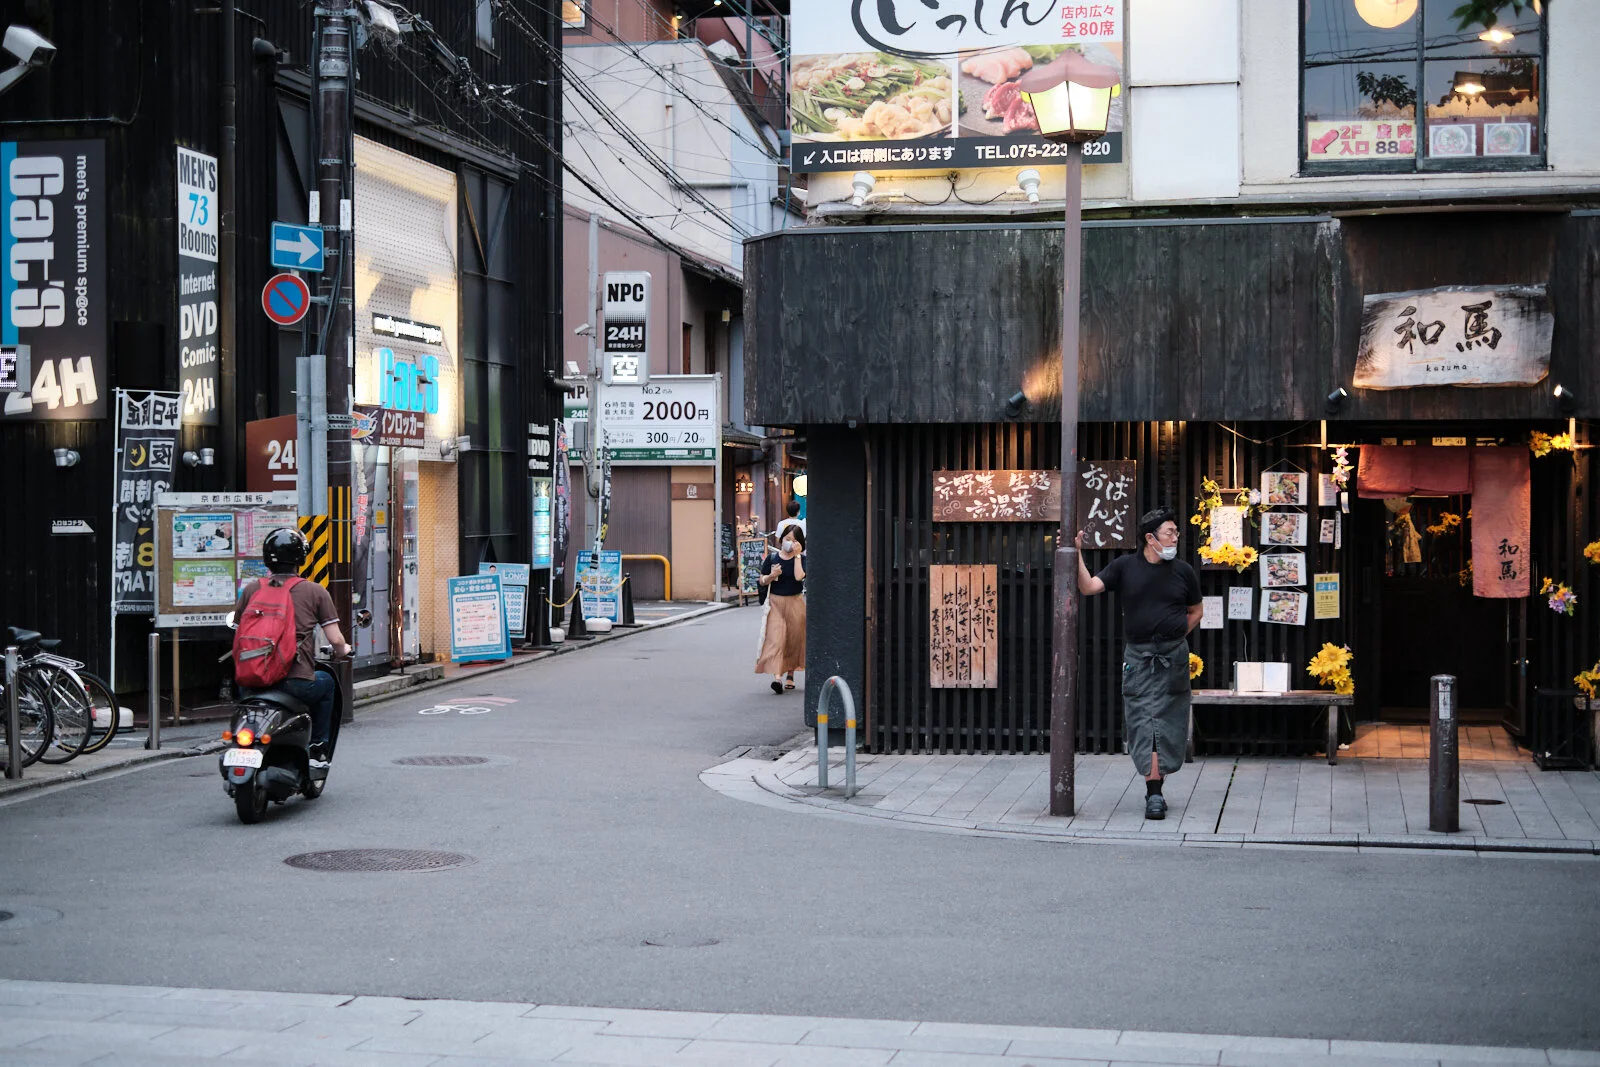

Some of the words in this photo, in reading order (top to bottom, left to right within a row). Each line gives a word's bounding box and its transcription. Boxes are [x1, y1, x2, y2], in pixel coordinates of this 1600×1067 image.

[1061, 4, 1115, 19] 店内広々
[1061, 20, 1115, 38] 全80席
[1340, 125, 1362, 140] 2F
[819, 146, 955, 165] 入口は南側にあります
[1339, 140, 1370, 156] 入口
[76, 155, 90, 201] men's
[179, 152, 216, 192] MEN'S
[189, 192, 208, 226] 73
[9, 156, 65, 327] Cat's
[74, 205, 90, 273] premium
[180, 222, 217, 257] Rooms
[181, 269, 216, 296] Internet
[607, 283, 644, 303] NPC
[74, 276, 89, 326] sp@ce
[180, 301, 218, 341] DVD
[607, 326, 643, 341] 24H
[1393, 300, 1503, 354] 和馬
[181, 341, 216, 369] Comic
[1425, 364, 1468, 372] kazuma
[183, 377, 216, 416] 24H
[642, 386, 661, 395] No.2
[642, 401, 709, 420] 2000円
[267, 439, 298, 470] 24
[528, 439, 550, 457] DVD
[201, 494, 263, 503] 京都市広報板
[1082, 463, 1134, 547] おばんざい
[1498, 538, 1519, 581] 和馬
